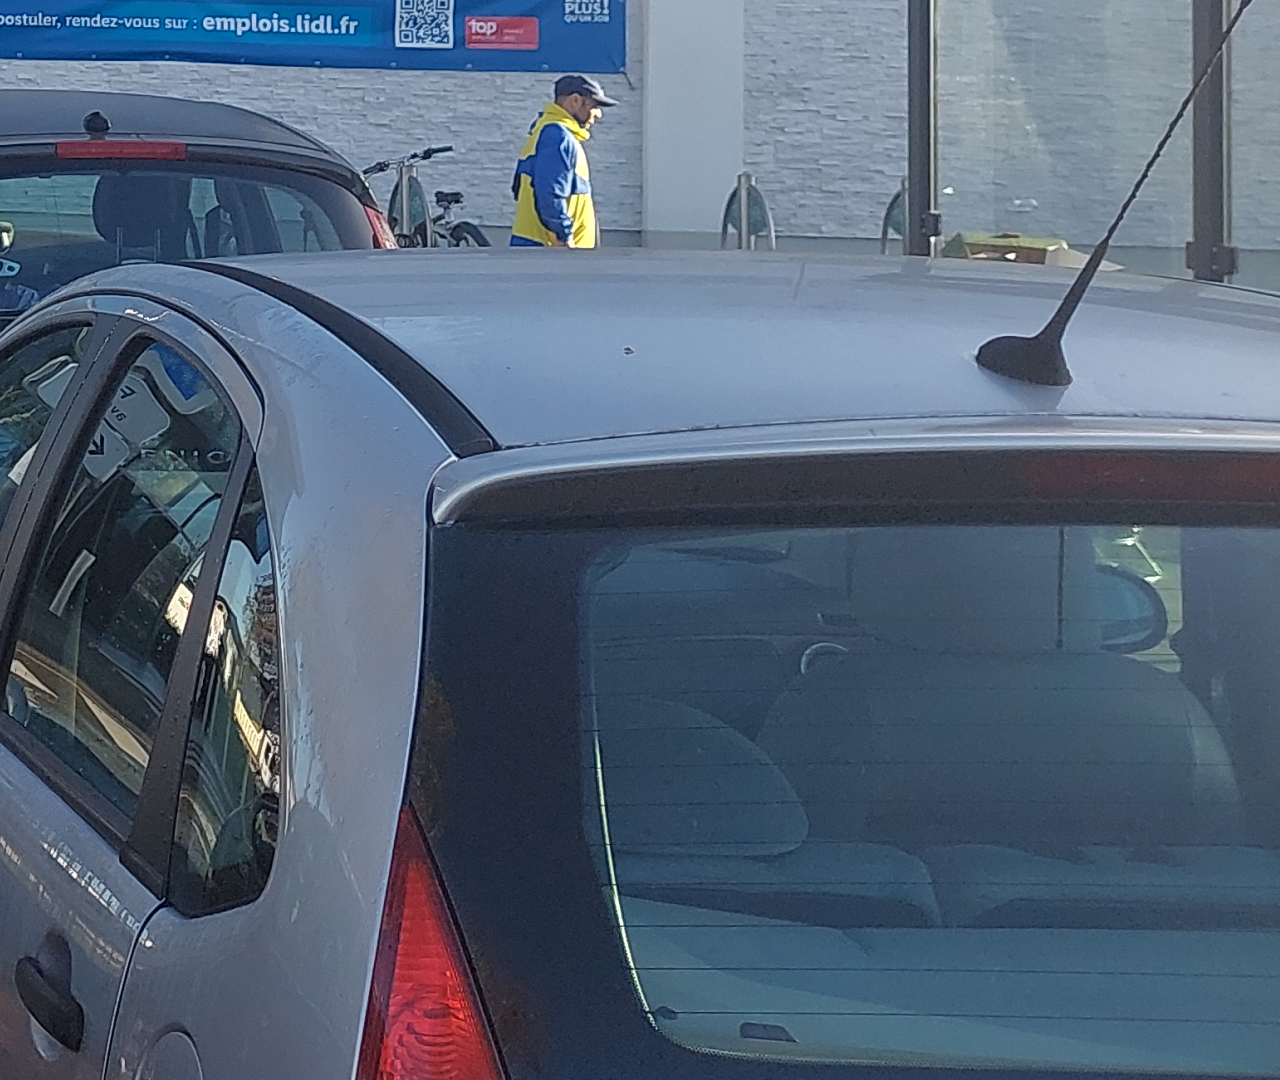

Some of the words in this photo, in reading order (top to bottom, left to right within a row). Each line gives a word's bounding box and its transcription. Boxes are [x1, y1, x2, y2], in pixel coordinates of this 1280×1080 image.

[65, 13, 160, 29] rendez-vous
[165, 17, 189, 29] sur
[202, 13, 359, 36] emplois.lidl.fr
